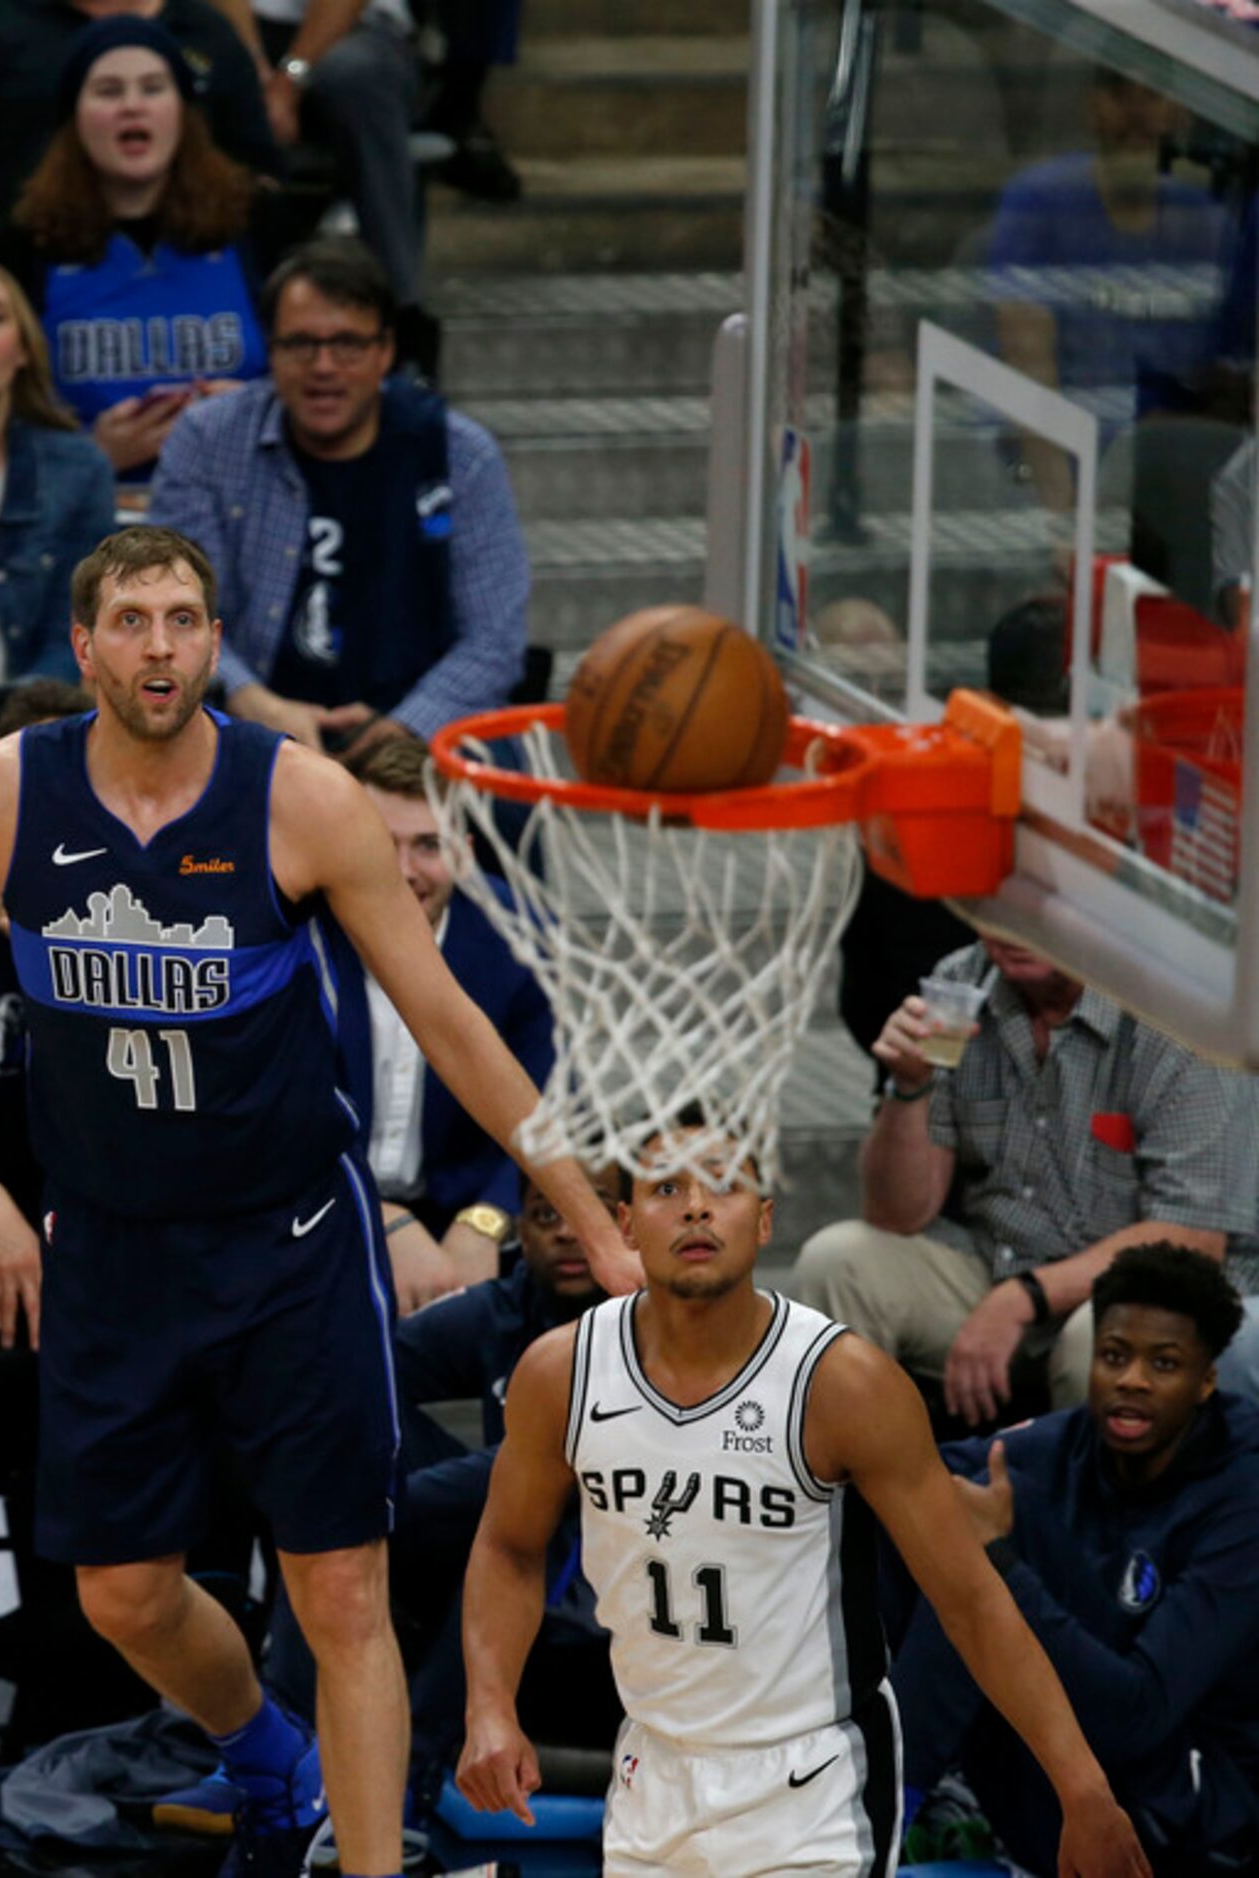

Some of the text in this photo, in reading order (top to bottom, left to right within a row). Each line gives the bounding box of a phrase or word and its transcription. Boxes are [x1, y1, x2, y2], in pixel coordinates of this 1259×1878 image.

[57, 312, 243, 383] DALLAS
[49, 946, 230, 1013] DALLAS
[106, 1027, 196, 1112] 41
[722, 1430, 773, 1453] Frost
[581, 1468, 796, 1541] SPURS
[645, 1555, 738, 1650] 11
